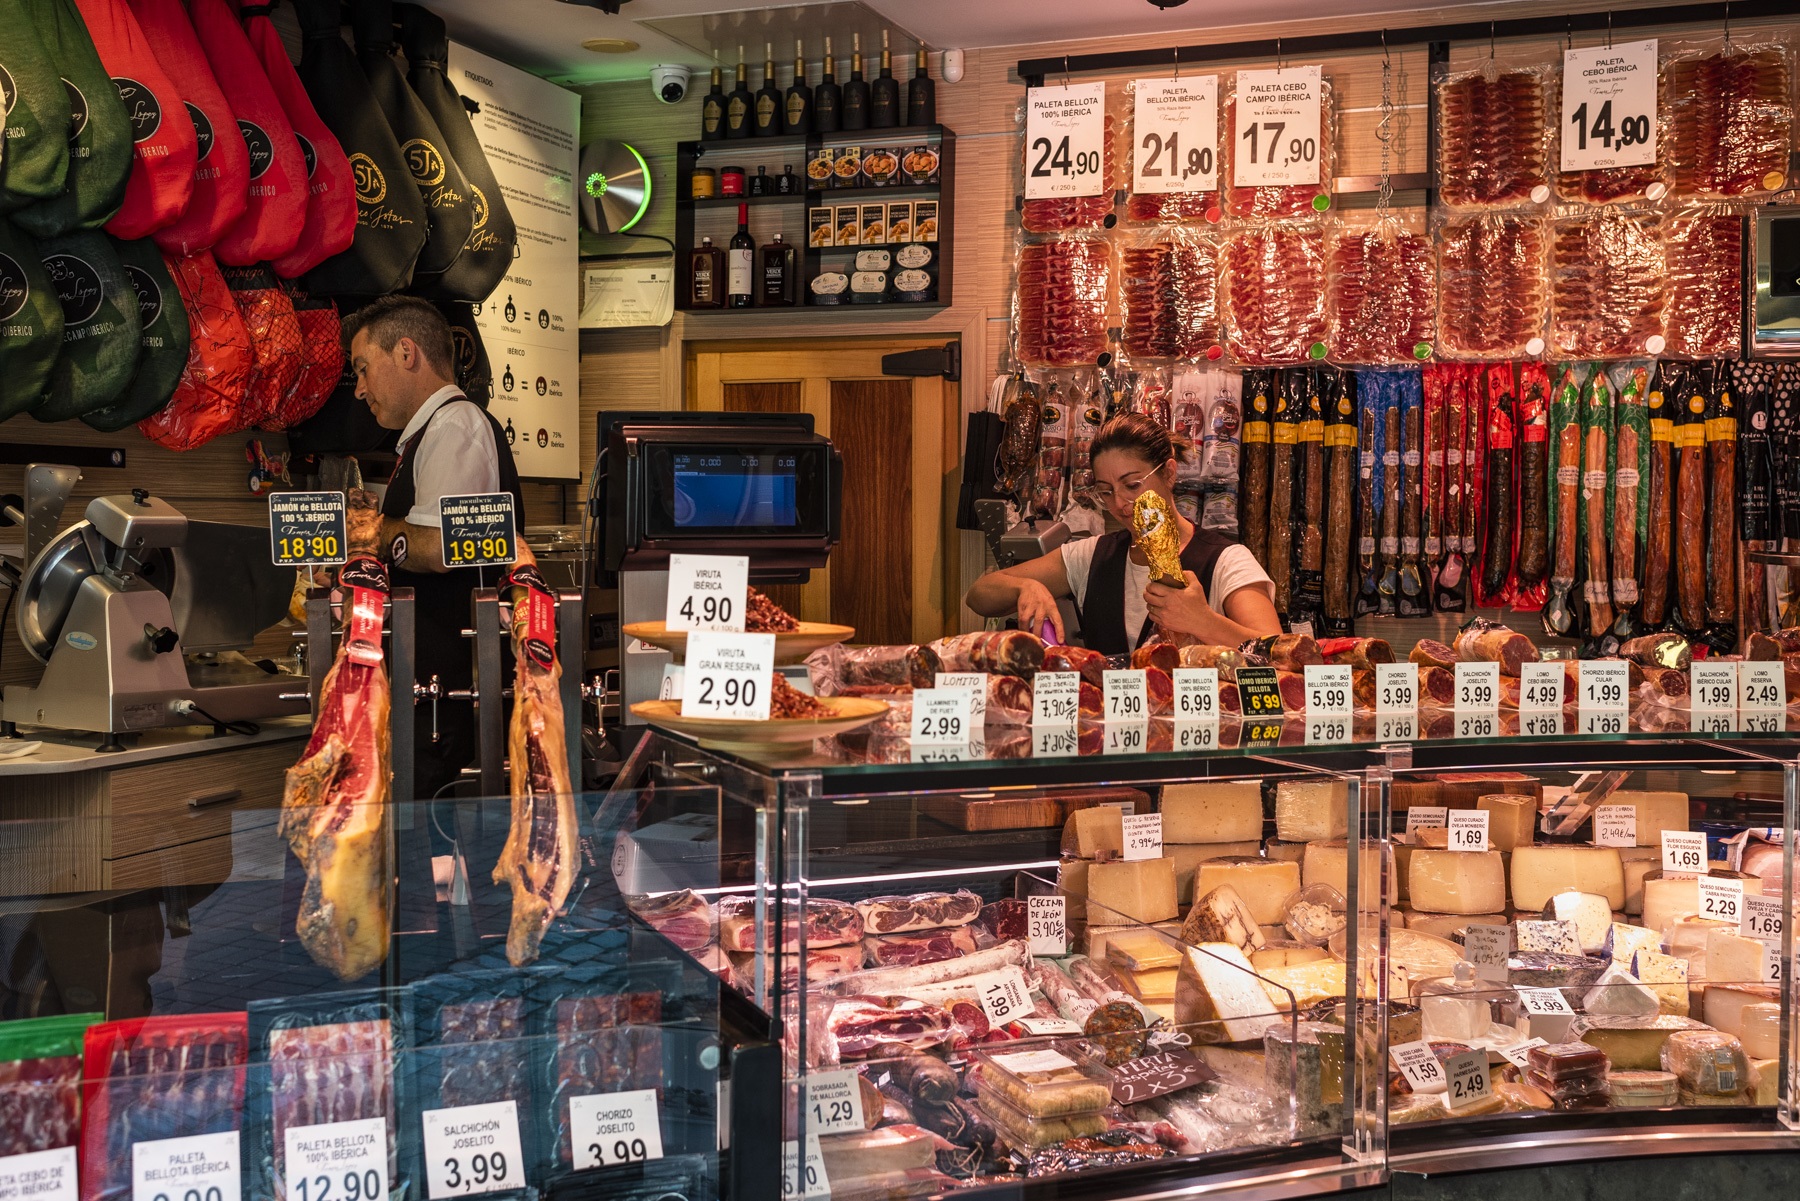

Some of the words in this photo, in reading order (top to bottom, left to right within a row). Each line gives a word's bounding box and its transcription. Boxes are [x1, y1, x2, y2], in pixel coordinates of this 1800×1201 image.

[1596, 58, 1624, 66] PALETA
[1607, 65, 1637, 74] IBÉRICA
[465, 70, 494, 88] ETIQUETADO:
[1284, 83, 1306, 91] CEBO
[1035, 101, 1062, 109] PALETA
[1065, 98, 1098, 106] BELLOTA
[1246, 95, 1276, 103] CAMPO
[1278, 93, 1311, 102] IBÉRICA
[1062, 108, 1091, 117] IBÉRICA
[1572, 100, 1649, 152] 14,90
[140, 145, 169, 157] IBERICO
[1243, 122, 1315, 167] 17,90
[410, 149, 431, 176] 5J
[1031, 135, 1099, 180] 24,90
[1141, 132, 1212, 180] 21,90
[354, 164, 372, 193] 5J
[515, 275, 532, 286] IBÉRICO
[552, 314, 563, 322] 100%
[507, 348, 525, 356] IBÉRICO
[779, 459, 795, 467] 0.00
[273, 502, 298, 512] JAMÓN
[311, 502, 342, 511] BELLOTA
[443, 504, 468, 515] JAMÓN
[480, 504, 511, 512] BELLOTA
[281, 514, 294, 522] 100
[296, 514, 304, 522] %
[451, 517, 464, 525] 100
[466, 516, 474, 524] %
[696, 570, 722, 579] VIRUTA
[693, 581, 722, 590] IBÉRICA
[680, 596, 732, 626] 4,90
[717, 648, 745, 658] VIRUTA
[699, 661, 722, 670] GRAN
[724, 662, 761, 671] RESERVA
[943, 677, 980, 686] LOMITO
[699, 677, 756, 710] 2,90
[1313, 690, 1345, 710] 5,99
[1383, 688, 1412, 707] 3,99
[1461, 686, 1491, 706] 3,99
[1527, 687, 1557, 705] 4,99
[1588, 685, 1621, 703] 1,99
[1699, 687, 1730, 705] 1,99
[1746, 686, 1778, 704] 2,49
[1111, 696, 1141, 717] 7,90
[1181, 694, 1212, 714] 6,99
[921, 717, 960, 738] 2,99
[1455, 830, 1481, 846] 1,69
[1670, 851, 1700, 867] 1,69
[1714, 885, 1741, 893] SEMICURADO
[1030, 898, 1063, 908] CECINA
[1706, 898, 1736, 915] 2,29
[1030, 911, 1039, 919] DE
[1032, 921, 1055, 938] 3,90
[1749, 916, 1782, 934] 1,69
[986, 984, 1009, 1017] 1,99
[1003, 983, 1016, 1008] ARTESANA
[1531, 1001, 1563, 1011] 3,99
[1408, 1062, 1438, 1082] 1,59
[1454, 1066, 1480, 1078] PARMESANO
[1458, 1060, 1473, 1070] QUESO
[812, 1082, 848, 1092] SOBRASADA
[1454, 1074, 1484, 1098] 2,49
[820, 1091, 852, 1100] MALLORCA
[596, 1108, 633, 1122] CHORIZO
[814, 1101, 853, 1127] 1,29
[444, 1120, 500, 1136] SALCHICHÓN
[596, 1121, 635, 1135] JOSELITO
[297, 1140, 332, 1152] PALETA
[334, 1134, 376, 1149] BELLOTA
[453, 1135, 494, 1149] JOSELITO
[169, 1152, 206, 1165] PALETA
[306, 1151, 328, 1164] 100%
[331, 1147, 368, 1161] IBÉRICA
[18, 1170, 48, 1185] CEBO
[50, 1167, 64, 1179] DE
[145, 1165, 188, 1181] BELLOTA
[192, 1160, 231, 1175] IBÉRICA
[444, 1151, 507, 1192] 3,99
[22, 1180, 63, 1195] IBÉRICA
